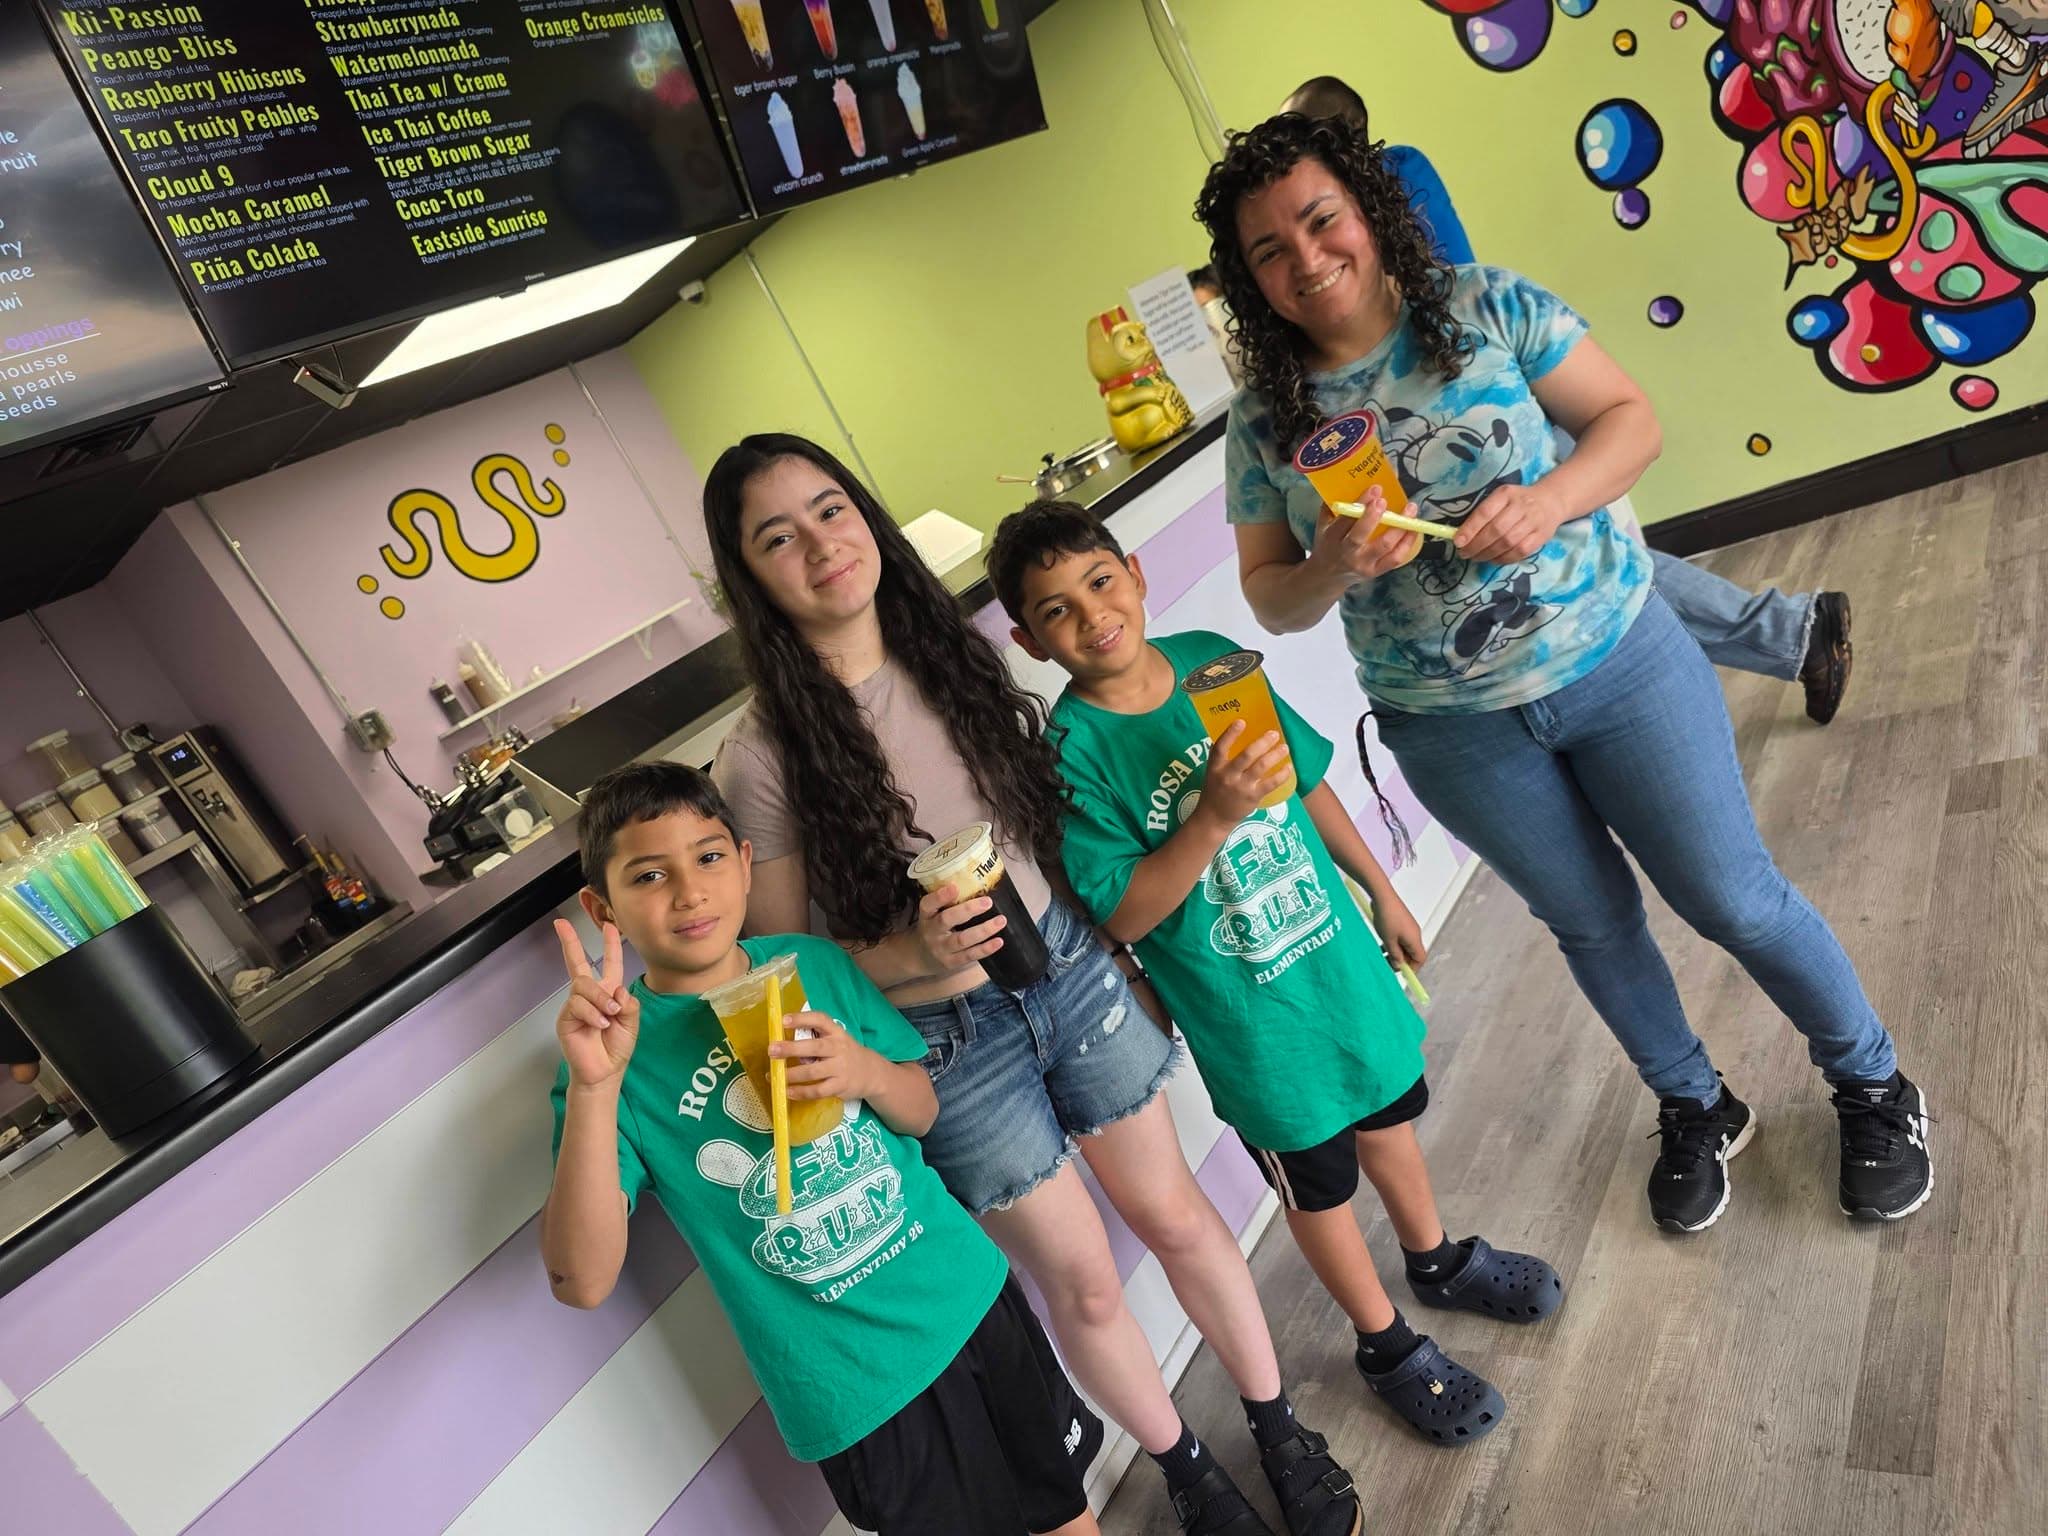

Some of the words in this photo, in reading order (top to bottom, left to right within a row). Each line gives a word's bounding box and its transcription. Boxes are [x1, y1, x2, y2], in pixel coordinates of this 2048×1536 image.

[61, 3, 203, 36] Kii-Passion
[98, 34, 114, 44] and
[117, 31, 150, 43] passion
[152, 28, 170, 37] fruit
[171, 26, 188, 35] fruit
[316, 7, 461, 42] Strawberrynada
[525, 18, 580, 38] Orange
[582, 4, 665, 31] Creamsicles
[80, 35, 238, 72] Peango-Bliss
[326, 44, 366, 54] Strawberry
[382, 39, 393, 47] tea
[330, 39, 480, 78] Watermelonnada
[94, 74, 125, 85] Peach
[128, 72, 144, 81] and
[146, 69, 175, 79] mango
[176, 65, 194, 74] fruit
[101, 79, 216, 111] Raspberry
[217, 67, 306, 94] Hibiscus
[345, 86, 390, 112] Thai
[390, 83, 424, 104] Tea
[428, 76, 448, 97] w/
[453, 71, 507, 94] Creme
[112, 111, 160, 123] Raspberry
[162, 106, 179, 116] fruit
[180, 105, 194, 113] tea
[196, 101, 213, 110] with
[222, 97, 238, 106] hint
[240, 95, 248, 104] of
[356, 110, 373, 120] Thai
[374, 109, 386, 117] tea
[387, 104, 410, 116] topped
[412, 101, 425, 111] with
[426, 101, 437, 109] our
[120, 128, 173, 152] Taro
[174, 116, 239, 143] Fruity
[240, 102, 319, 131] Pebbles
[134, 153, 156, 162] Taro
[184, 145, 199, 153] tea
[204, 137, 242, 150] smoothie
[246, 130, 274, 143] topped
[279, 127, 295, 137] with
[361, 125, 394, 146] Ice
[394, 115, 435, 140] Thai
[436, 108, 492, 132] Coffee
[0, 152, 38, 174] ruit
[140, 161, 168, 171] cream
[170, 156, 186, 166] and
[187, 153, 208, 163] fruity
[210, 148, 238, 161] pebble
[374, 155, 424, 178] Tiger
[426, 143, 482, 168] Brown
[483, 132, 531, 156] Sugar
[147, 168, 215, 200] Cloud
[217, 165, 234, 186] 9
[158, 202, 168, 210] In
[170, 197, 196, 207] house
[198, 189, 226, 203] special
[228, 185, 245, 196] with
[246, 184, 262, 192] four
[264, 180, 271, 189] of
[272, 179, 287, 187] our
[288, 172, 316, 186] popular
[317, 167, 334, 178] milk
[464, 175, 472, 184] IS
[166, 206, 242, 238] Mocha
[245, 185, 332, 221] Caramel
[396, 188, 485, 220] Coco-Toro
[405, 222, 413, 230] In
[414, 218, 434, 228] house
[473, 204, 485, 214] and
[176, 235, 207, 247] Mocha
[208, 226, 246, 240] smoothie
[248, 221, 263, 232] with
[271, 216, 286, 226] hint
[288, 214, 296, 223] of
[297, 207, 327, 221] caramel
[328, 201, 354, 214] topped
[354, 198, 370, 208] with
[184, 243, 218, 258] whipped
[220, 239, 245, 250] cream
[247, 233, 262, 244] and
[264, 228, 288, 240] salted
[289, 220, 324, 234] chocolate
[412, 222, 485, 256] Eastside
[486, 210, 548, 237] Sunrise
[190, 256, 244, 285] Piña
[247, 238, 320, 271] Colada
[456, 245, 469, 255] and
[470, 240, 489, 253] peach
[203, 277, 244, 293] Pineapple
[246, 272, 262, 283] with
[263, 264, 296, 279] Coconut
[313, 258, 327, 267] tea
[12, 370, 76, 400] pearls
[0, 396, 57, 420] seeds
[1209, 698, 1240, 714] mango
[1147, 760, 1194, 832] ROSA
[1184, 736, 1214, 768] PA
[1227, 876, 1325, 949] RUN
[1255, 925, 1336, 984] ELEMENTARY
[772, 1176, 892, 1269] RUN
[909, 1220, 924, 1242] 26
